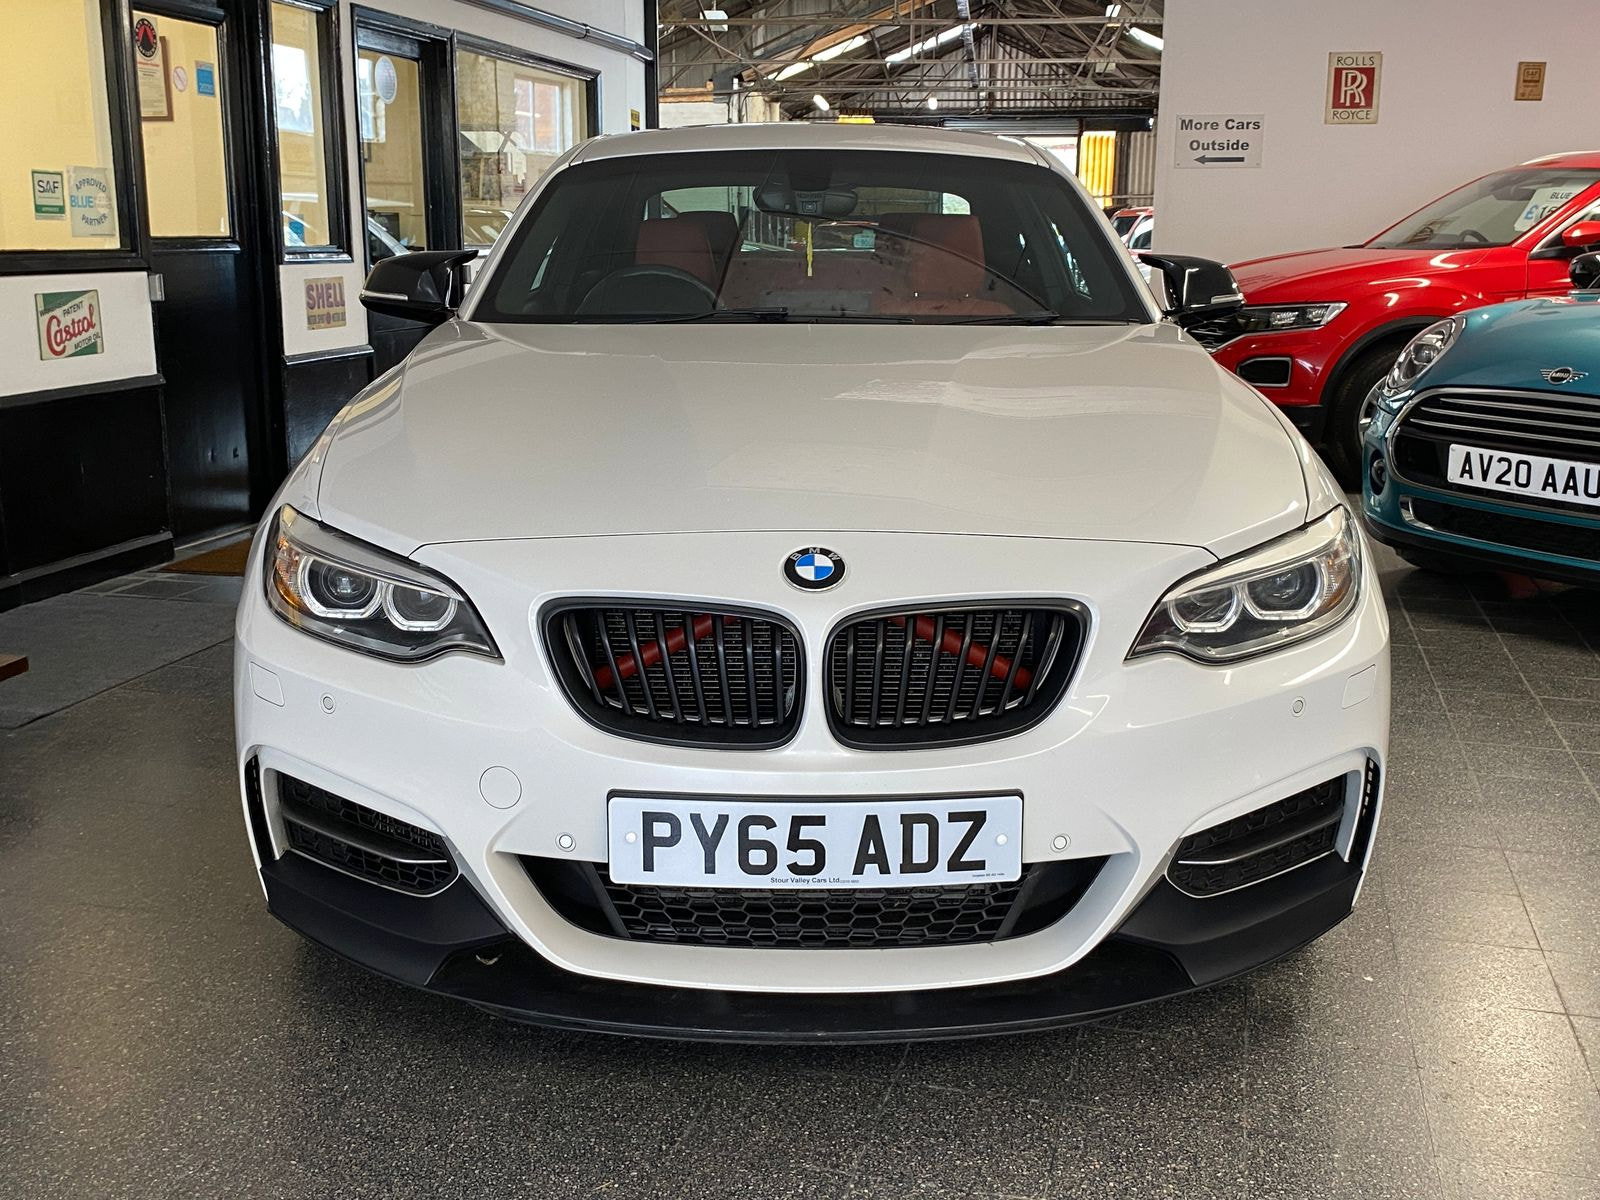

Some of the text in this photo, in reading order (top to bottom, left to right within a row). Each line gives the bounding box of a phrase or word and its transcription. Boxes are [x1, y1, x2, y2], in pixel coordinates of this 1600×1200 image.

[1336, 56, 1375, 66] ROLLS
[1332, 110, 1372, 120] ROYCE
[1180, 118, 1261, 130] More Cars
[1189, 139, 1249, 151] Outside
[37, 179, 59, 193] SAF
[75, 177, 107, 193] APPROVED
[70, 195, 94, 208] BLUE
[81, 213, 108, 226] PARTNER
[305, 282, 345, 310] SHELL
[63, 300, 84, 317] PATENT
[46, 303, 96, 356] Castrol
[74, 335, 92, 350] MOTOR
[1459, 451, 1600, 499] AV20 AAU
[790, 547, 841, 561] BMW
[641, 810, 988, 876] PY65 ADZ
[790, 877, 810, 885] Valley
